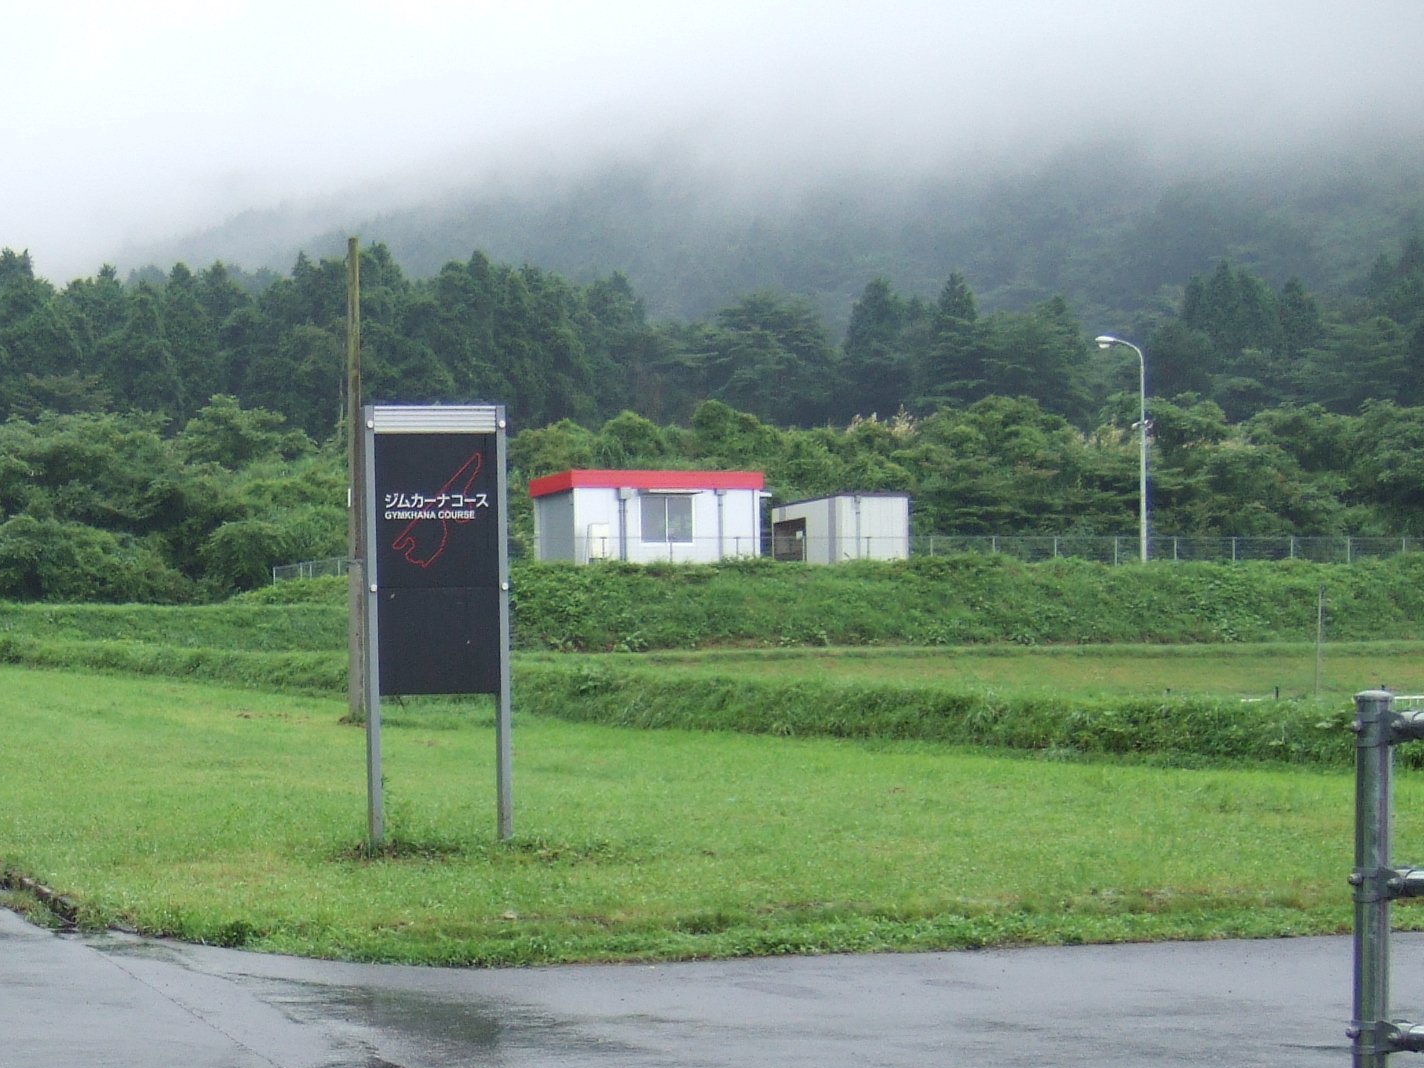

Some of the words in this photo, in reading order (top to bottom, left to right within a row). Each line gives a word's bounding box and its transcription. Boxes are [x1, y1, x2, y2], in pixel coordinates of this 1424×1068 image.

[384, 493, 489, 508] ジムカーナコース
[384, 510, 436, 520] GYMKHANA
[437, 510, 476, 520] COURSE
